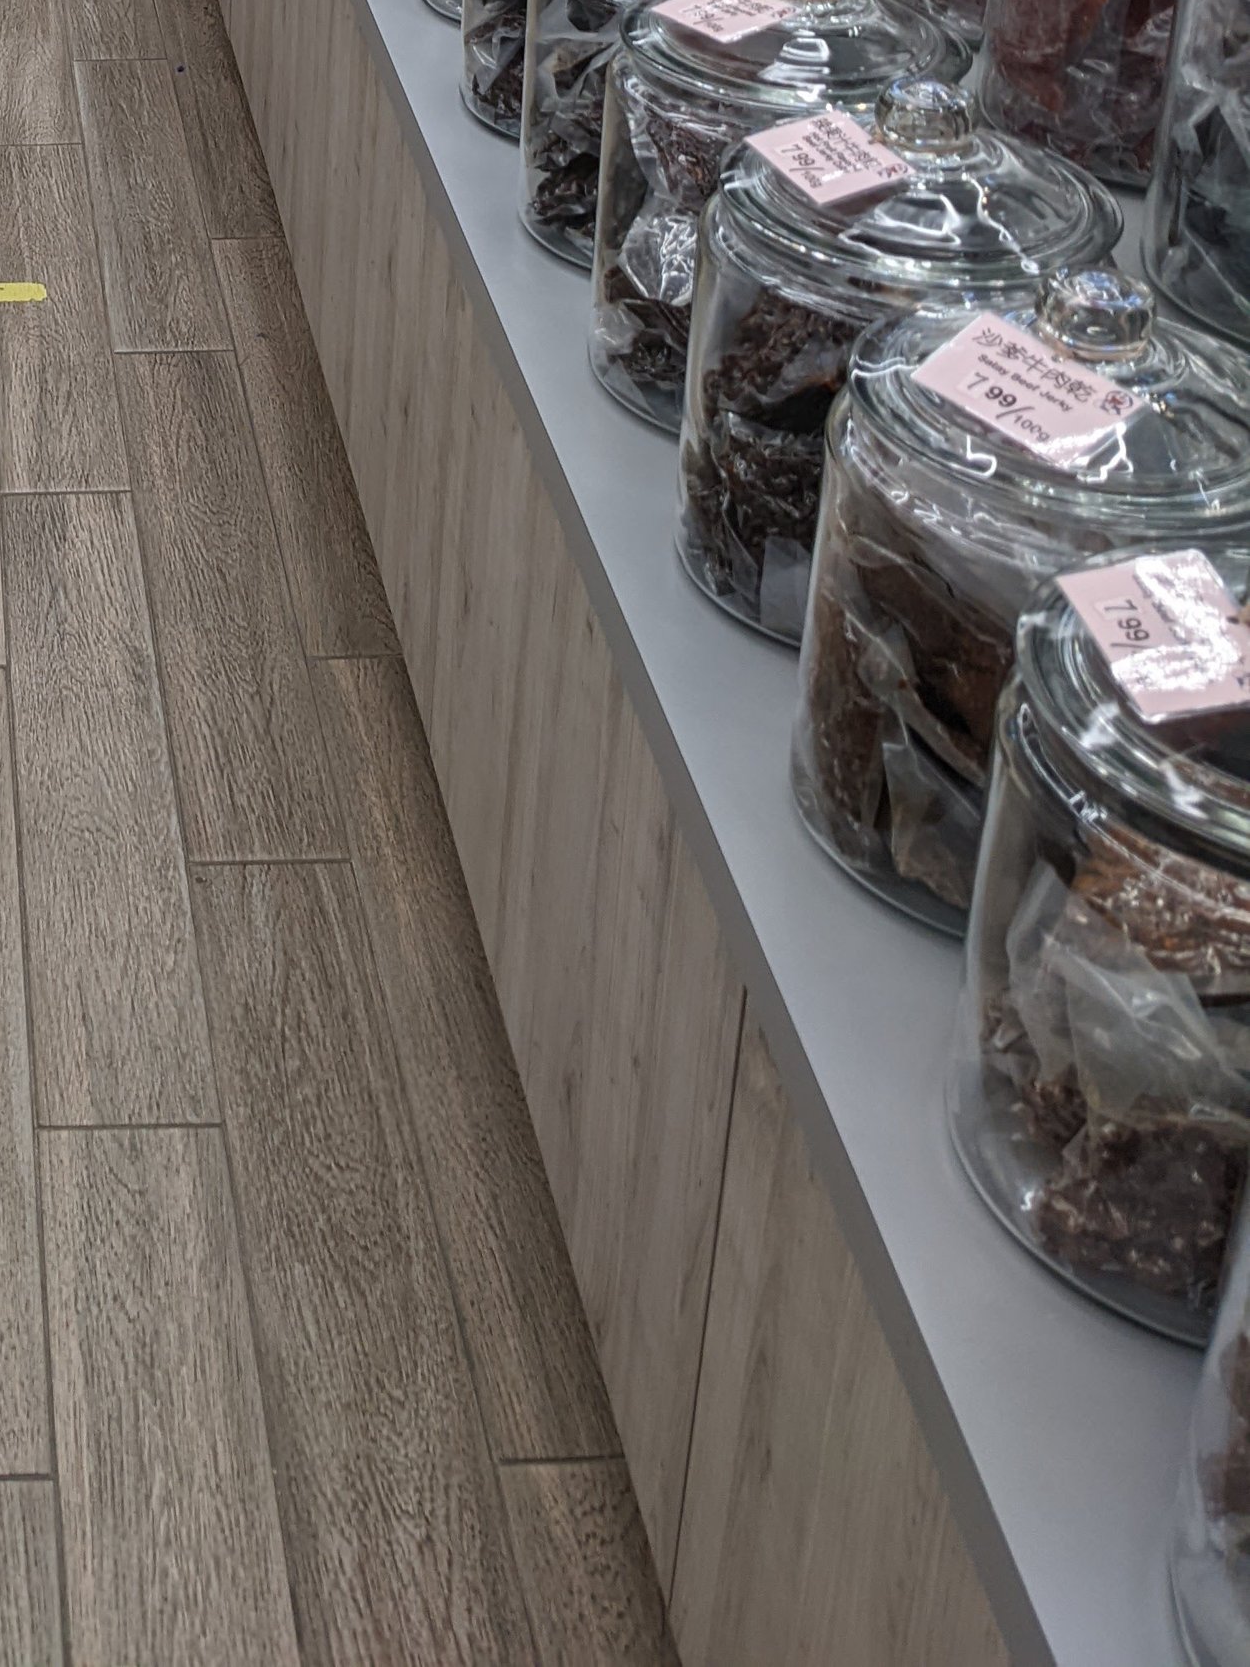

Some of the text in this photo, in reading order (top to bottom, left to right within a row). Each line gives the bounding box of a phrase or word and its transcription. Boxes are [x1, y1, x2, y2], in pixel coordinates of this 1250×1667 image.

[977, 353, 1074, 413] Satay Beef Jerky
